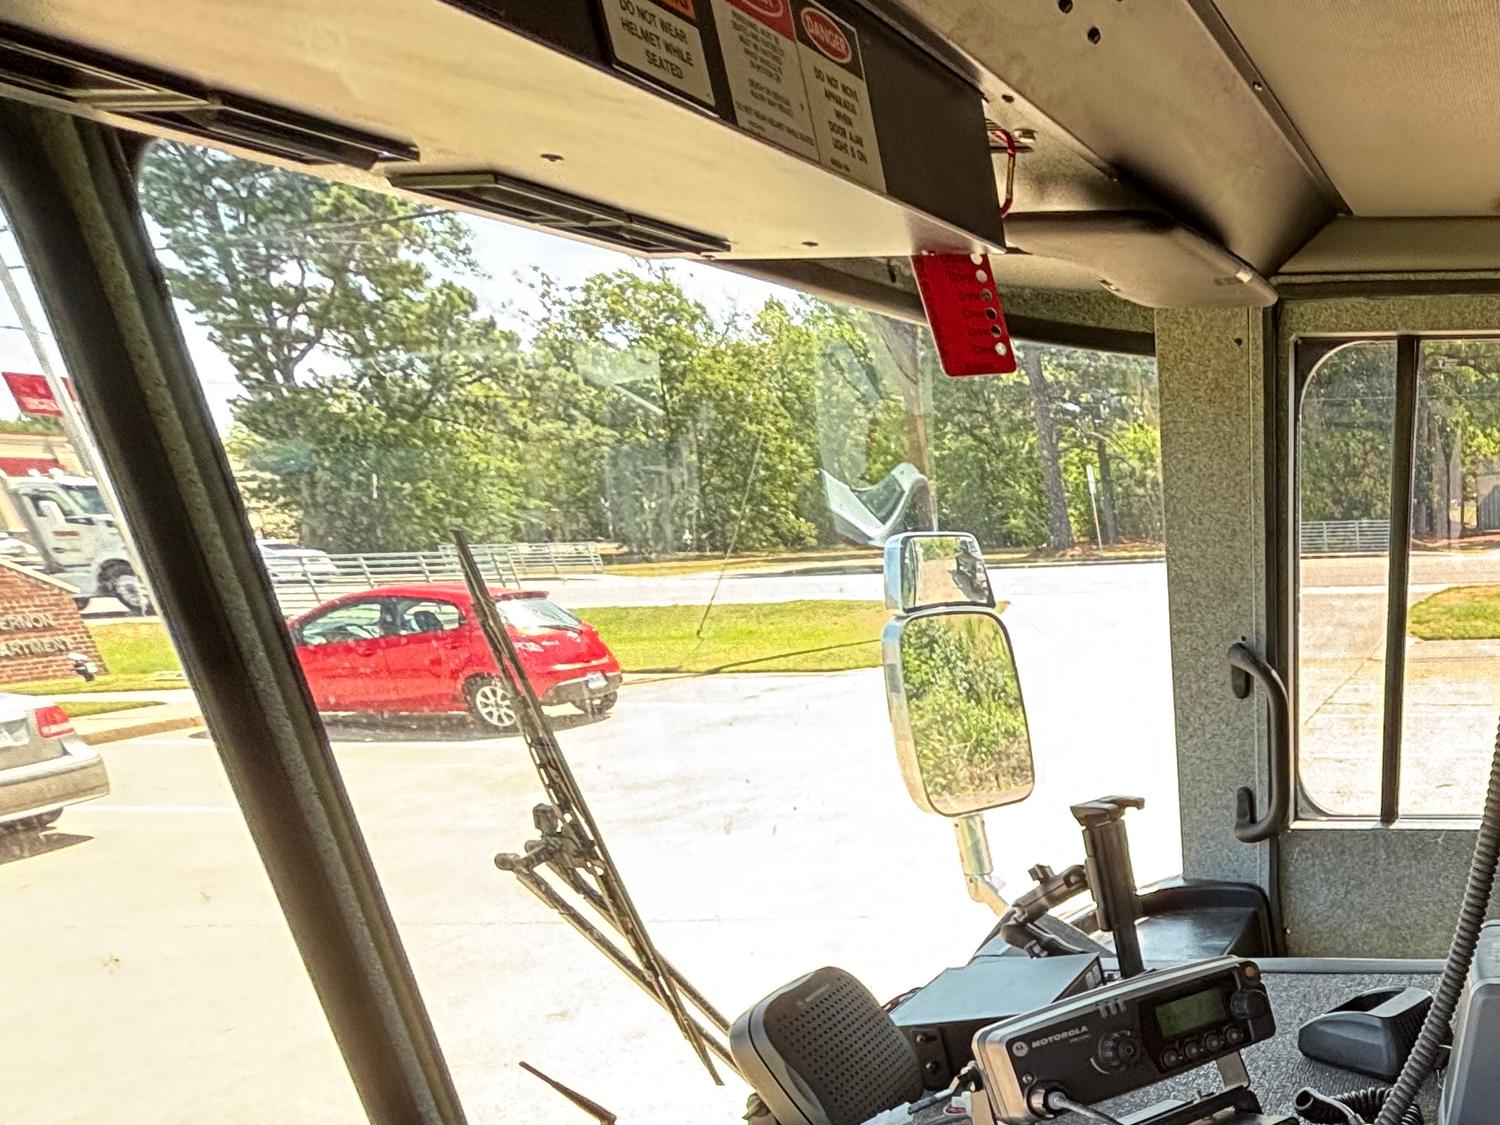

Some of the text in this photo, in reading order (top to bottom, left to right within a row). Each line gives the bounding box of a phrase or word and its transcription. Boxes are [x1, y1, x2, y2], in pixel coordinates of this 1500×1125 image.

[620, 17, 693, 67] HELMET WHILE
[636, 5, 658, 28] NOT
[659, 18, 689, 45] WEAR
[805, 14, 848, 55] DANGER
[645, 49, 683, 79] SEATED
[1031, 1025, 1089, 1049] MOTOROLA
